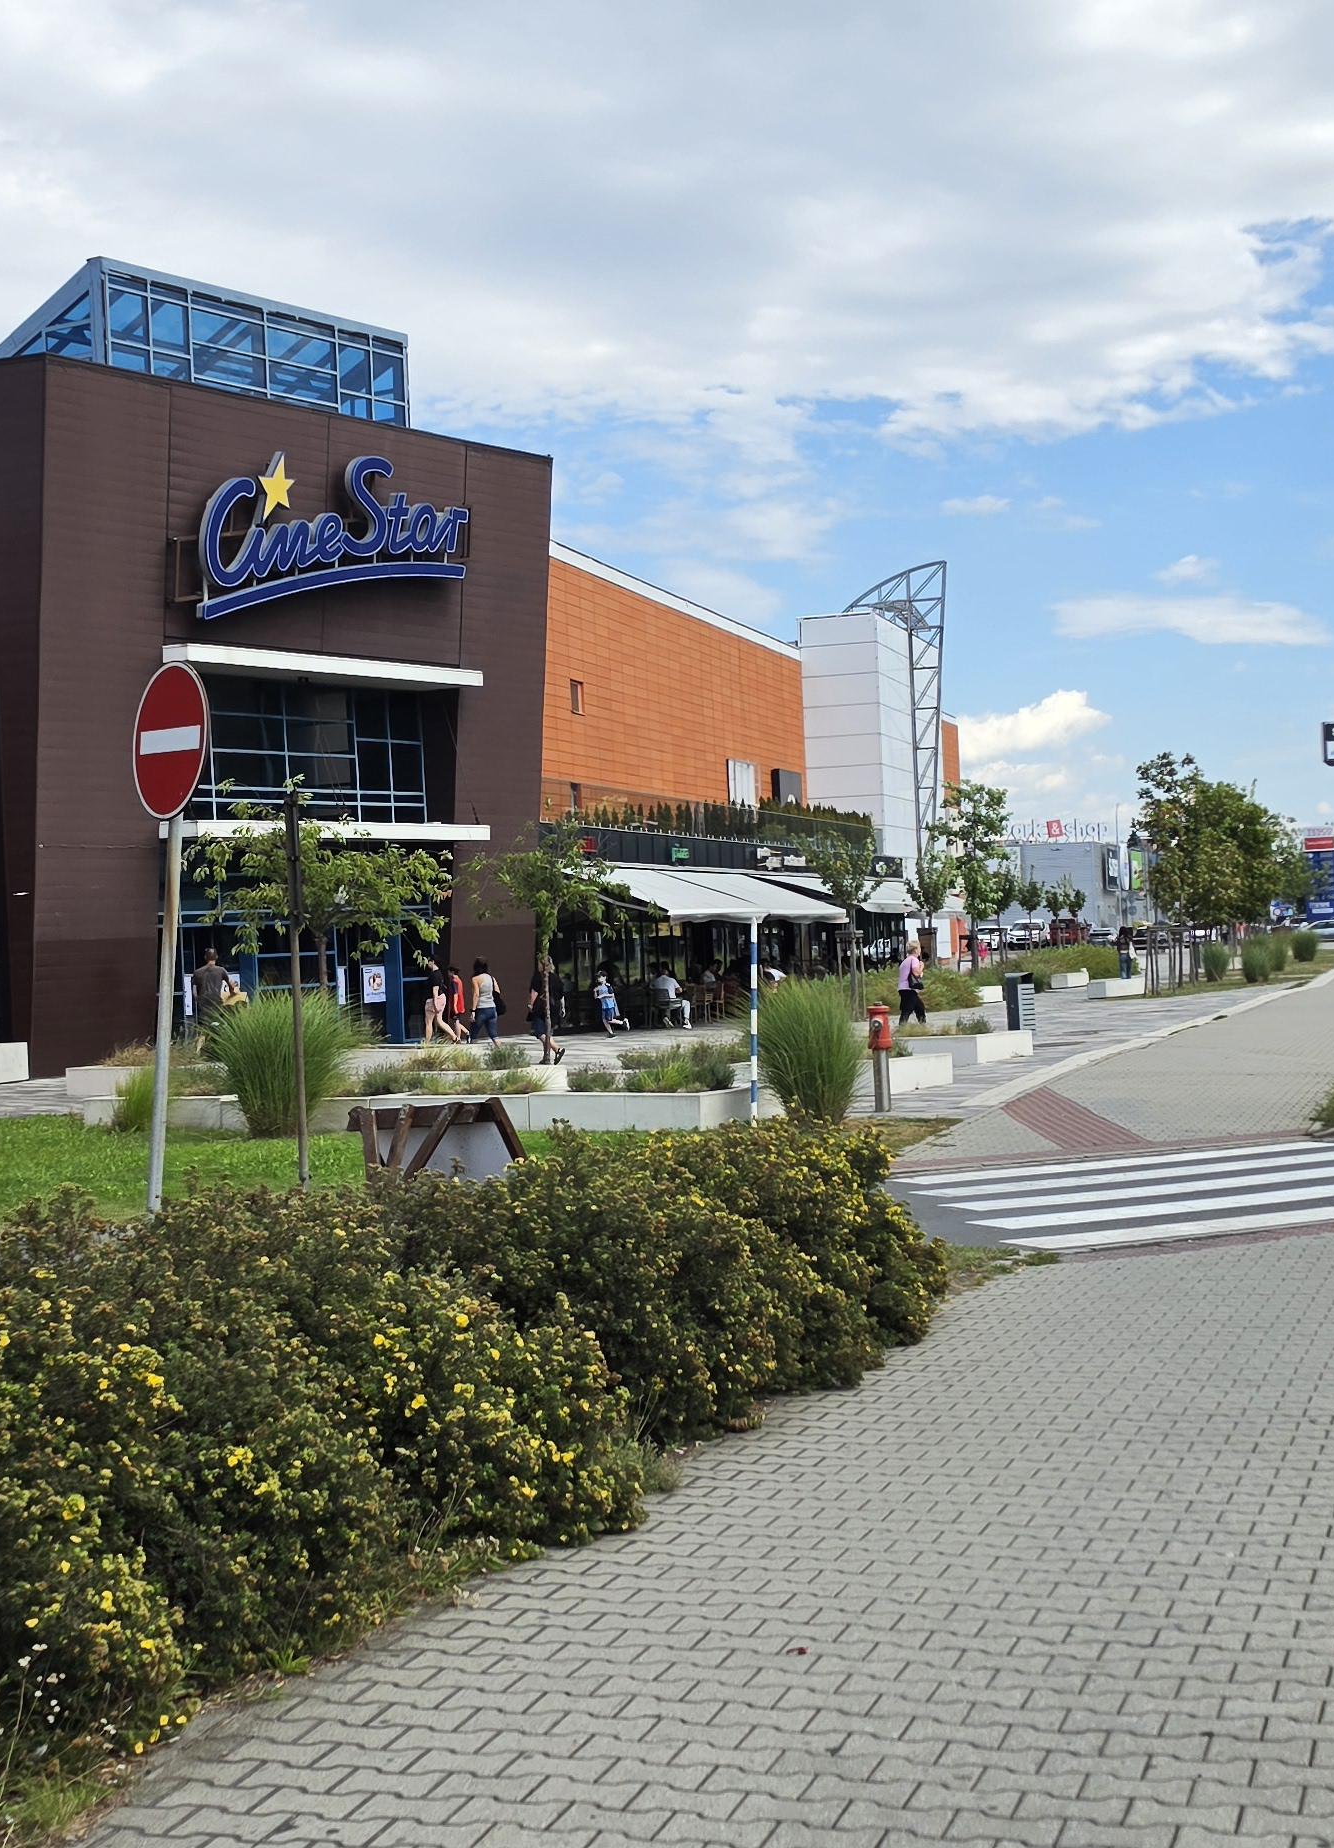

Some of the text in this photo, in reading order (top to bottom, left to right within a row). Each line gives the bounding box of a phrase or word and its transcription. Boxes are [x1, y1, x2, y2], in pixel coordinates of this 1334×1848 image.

[199, 454, 470, 588] CineStar
[1004, 818, 1109, 841] ark & shop
